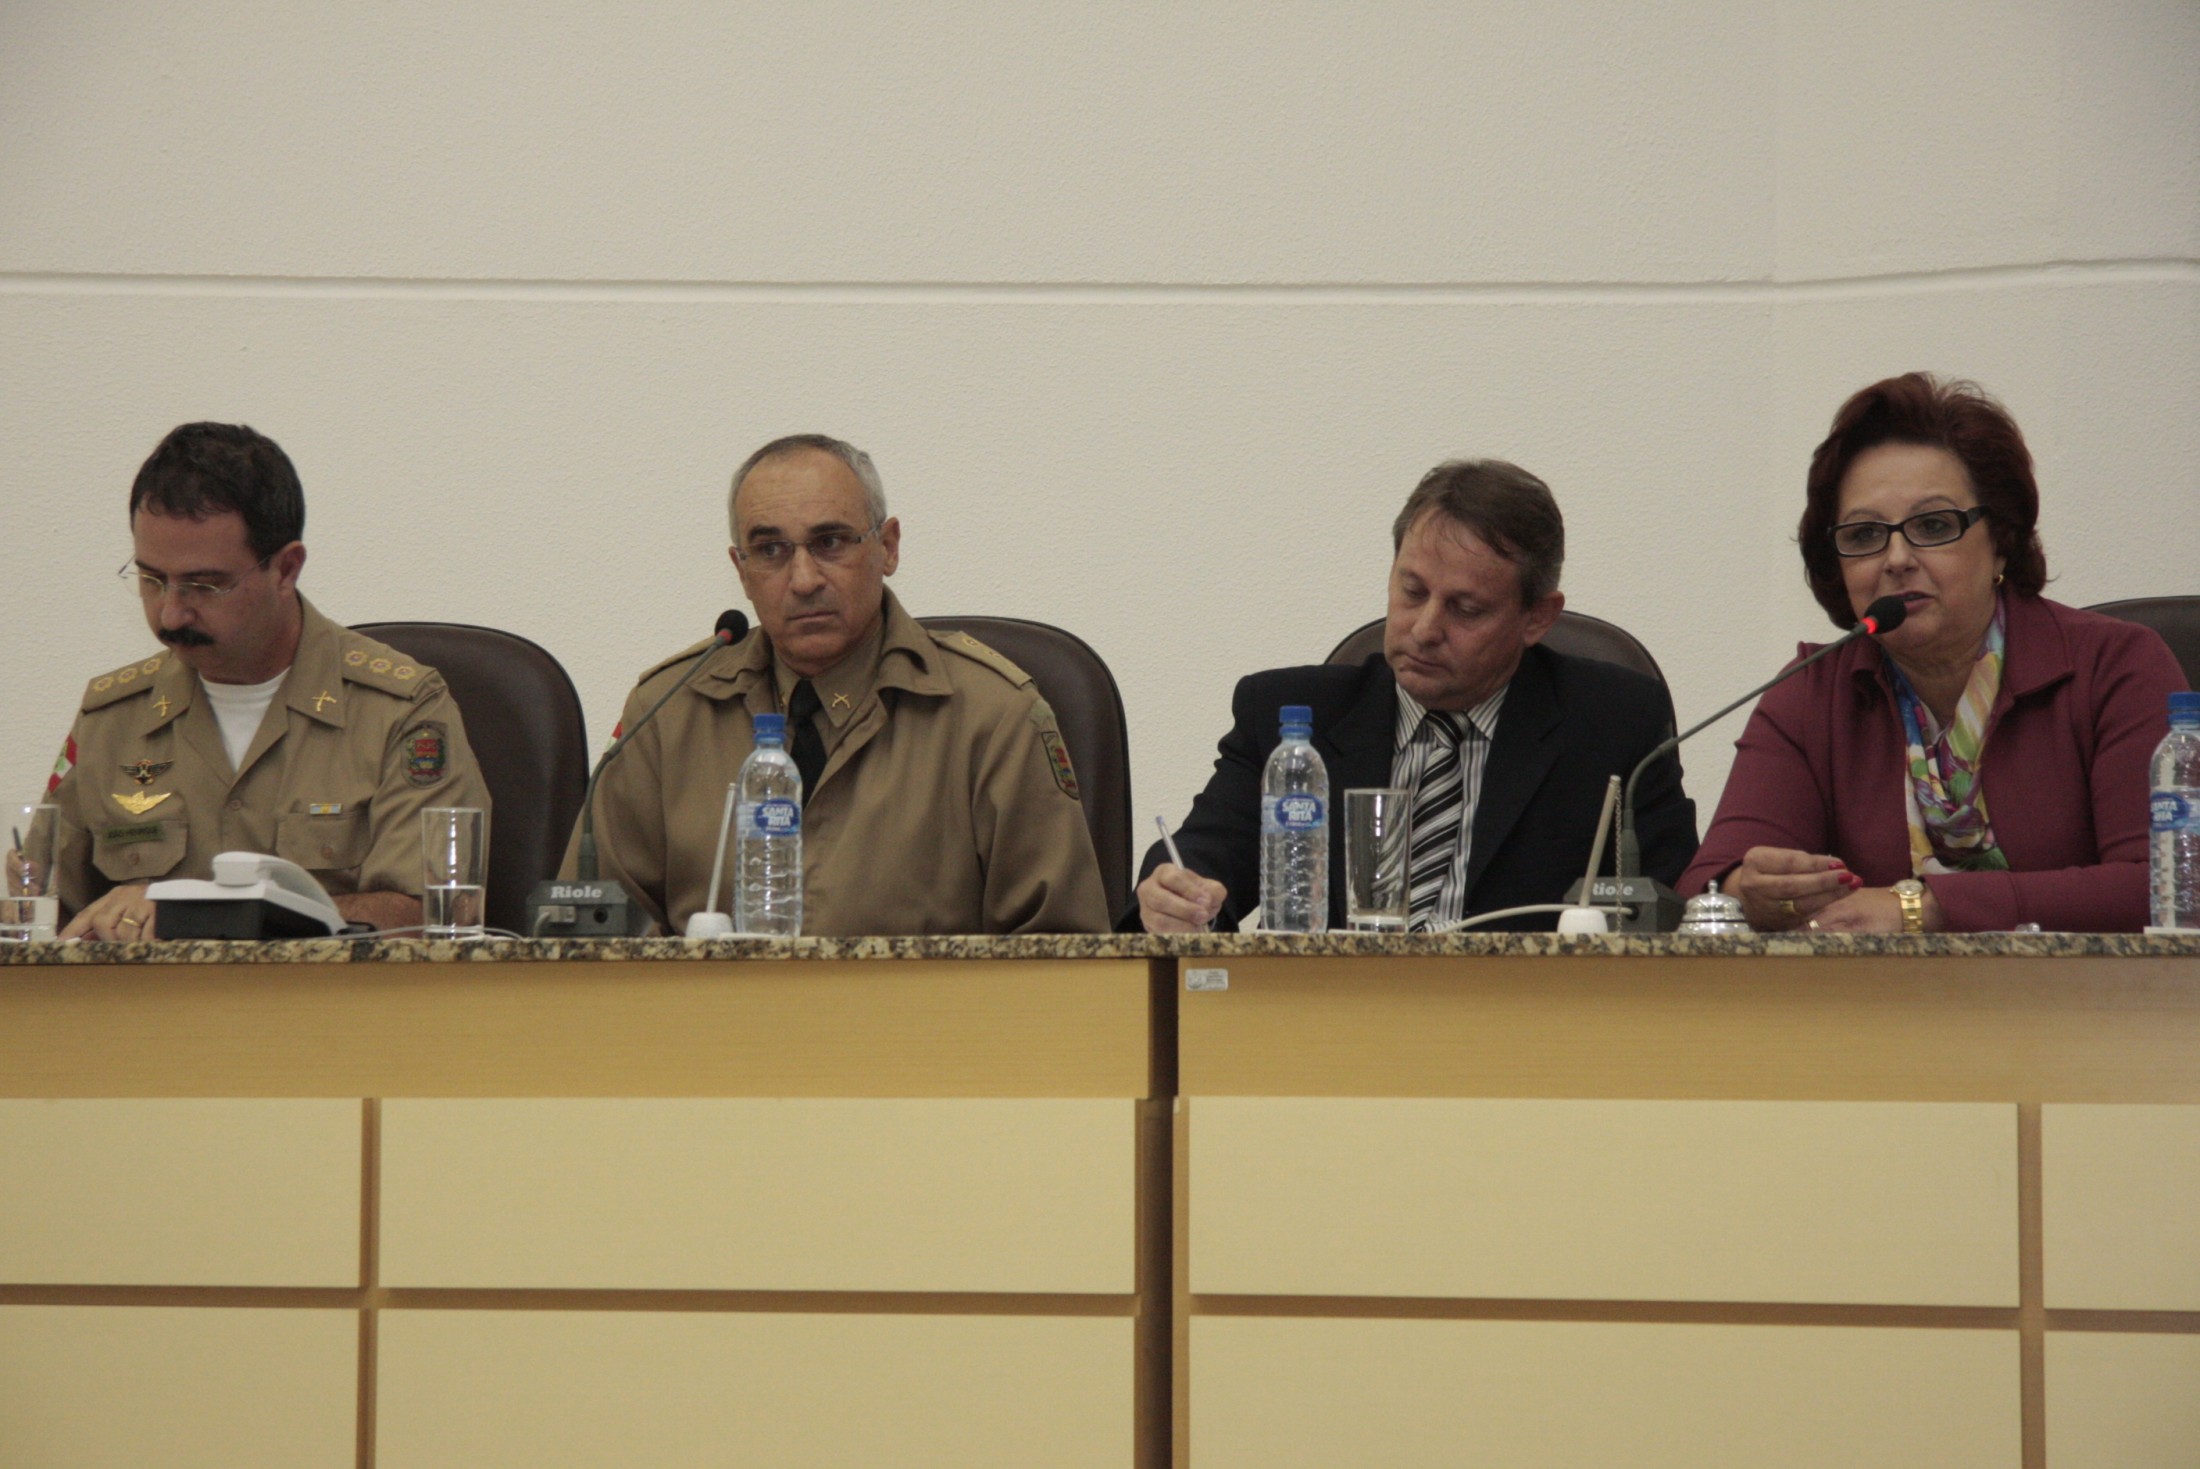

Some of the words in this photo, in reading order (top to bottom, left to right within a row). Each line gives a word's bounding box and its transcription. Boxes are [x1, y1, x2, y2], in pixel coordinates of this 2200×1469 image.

[762, 806, 794, 818] SANTA
[1282, 801, 1316, 813] SANTA
[767, 816, 791, 827] RITA
[1288, 811, 1313, 822] RITA
[551, 885, 602, 899] Riole
[1591, 882, 1634, 896] ioe
